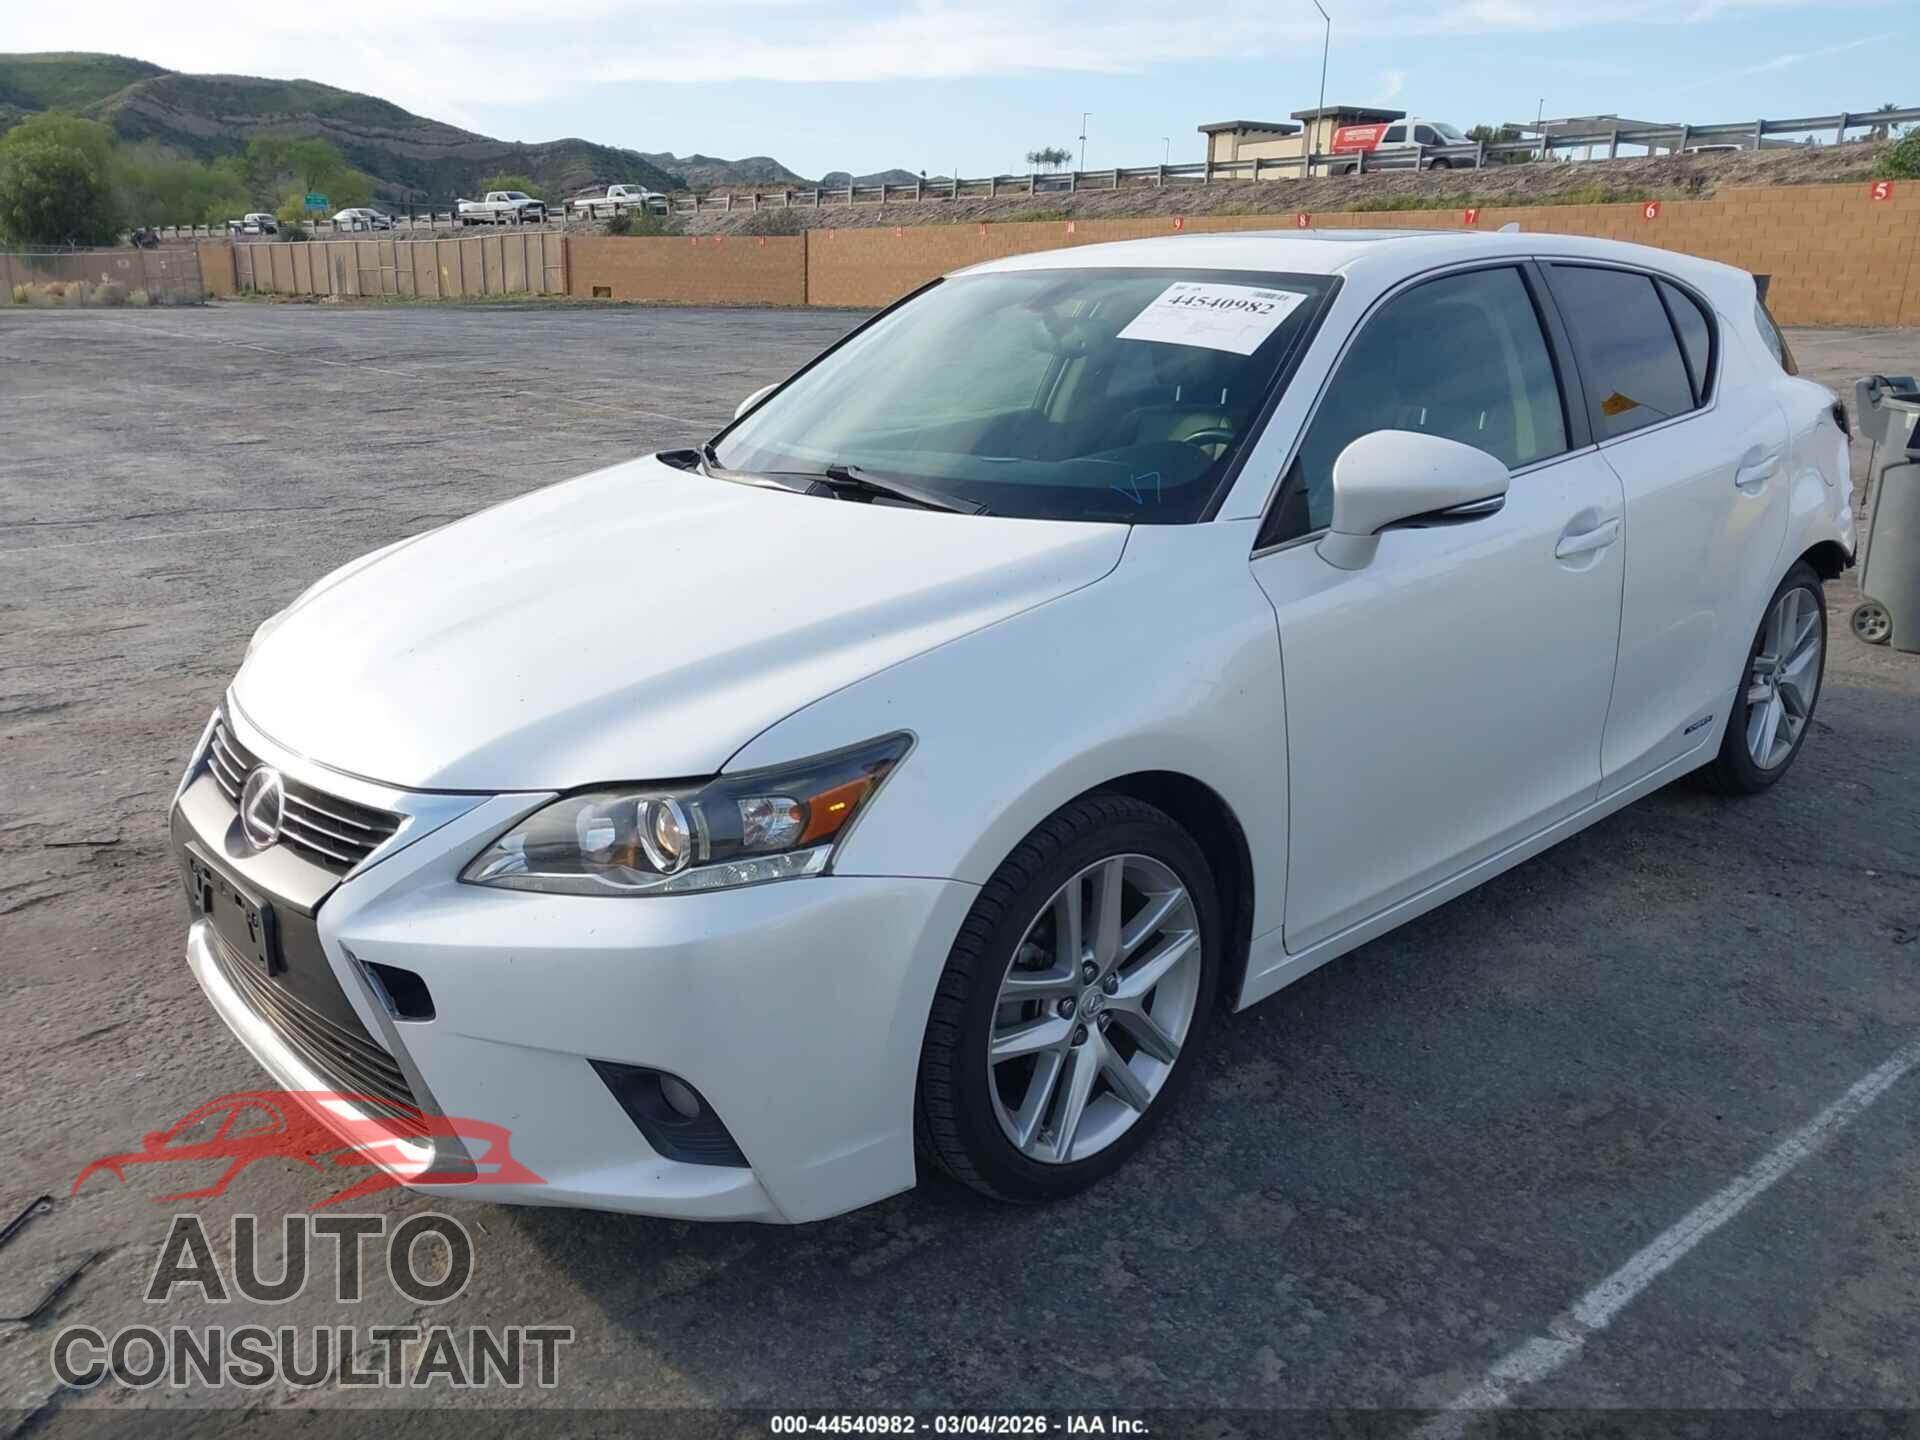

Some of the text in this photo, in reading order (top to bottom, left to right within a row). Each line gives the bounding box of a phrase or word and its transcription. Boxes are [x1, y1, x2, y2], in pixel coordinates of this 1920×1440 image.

[1873, 181, 1888, 200] 5
[1467, 208, 1476, 223] 7
[1645, 202, 1656, 218] 6
[1173, 216, 1181, 230] 9
[1299, 214, 1306, 228] 8
[1168, 294, 1275, 315] 44540982
